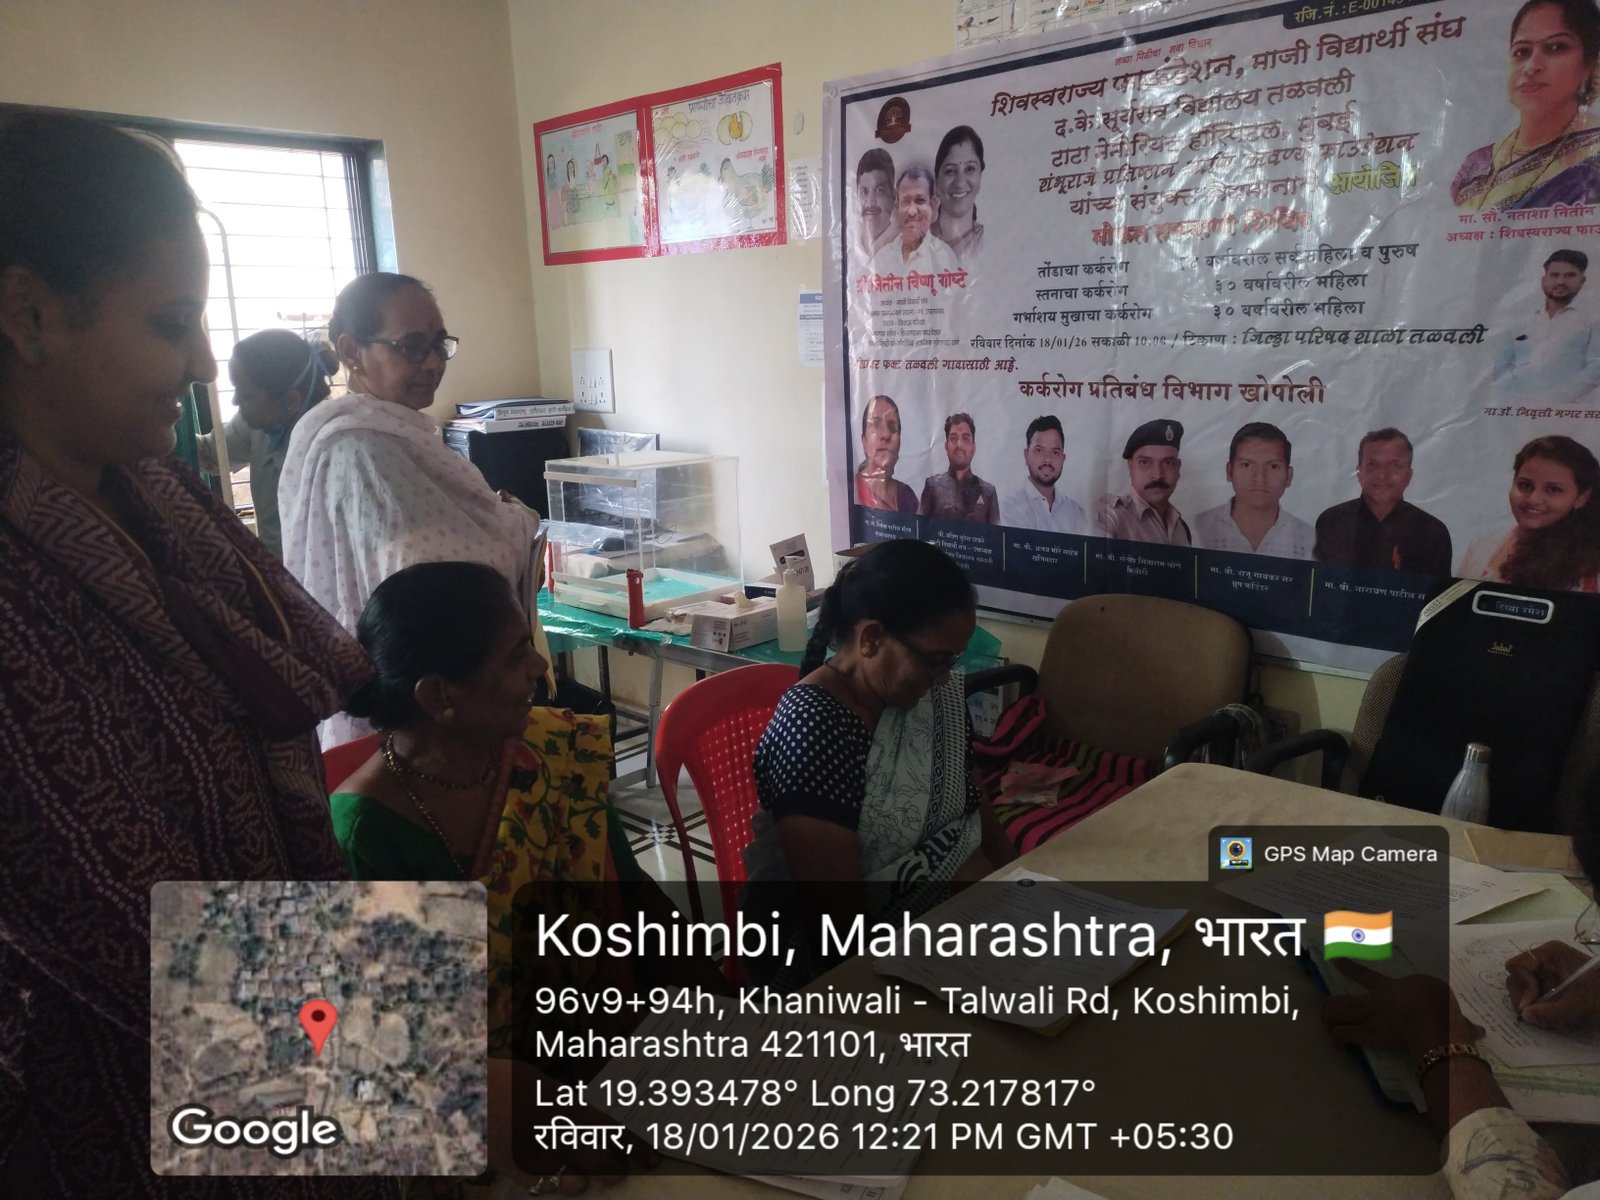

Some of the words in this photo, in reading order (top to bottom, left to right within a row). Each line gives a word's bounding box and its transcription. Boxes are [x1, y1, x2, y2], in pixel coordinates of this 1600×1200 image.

[990, 77, 1108, 117] शिवस्वराज्य
[1252, 39, 1311, 70] माजी
[1316, 17, 1412, 62] विद्यार्थी
[1416, 12, 1467, 45] संघ
[1267, 67, 1356, 105] तळवली
[1051, 145, 1091, 167] टाटा
[1102, 161, 1179, 185] प्रतिष्ठान
[1458, 213, 1477, 225] मा.
[1506, 208, 1550, 222] नताशा
[1553, 202, 1596, 219] नितीन
[1447, 231, 1486, 243] अध्यक्ष
[1499, 225, 1573, 240] शिवस्वराज्य
[1037, 260, 1080, 279] तोंडाचा
[1082, 256, 1130, 277] कर्करोग
[1361, 245, 1374, 261] व
[1035, 285, 1079, 302] स्तनाचा
[1081, 280, 1129, 300] कर्करोग
[1243, 271, 1309, 292] वर्षावरील
[1316, 269, 1369, 290] महिला
[1012, 306, 1058, 325] गर्भाशय
[1060, 309, 1102, 327] मुखाचा
[1104, 303, 1154, 322] कर्करोग
[1241, 296, 1310, 318] वर्षावरील
[1314, 297, 1367, 317] महिला
[970, 334, 1003, 350] रविवार
[1005, 333, 1037, 351] दिनांक
[1039, 335, 1088, 350] 18/01/26
[1091, 331, 1132, 348] सकाळी
[1296, 327, 1352, 346] परिषद
[1354, 327, 1404, 345] शाळा
[1409, 323, 1489, 345] तळवली
[905, 356, 939, 370] तळवली
[942, 356, 992, 370] गावासाठी
[994, 356, 1019, 373] आहे.
[1018, 372, 1084, 399] कर्करोग
[1088, 373, 1158, 400] प्रतिबंध
[1163, 374, 1233, 401] विभाग
[1238, 374, 1328, 404] खोपोली
